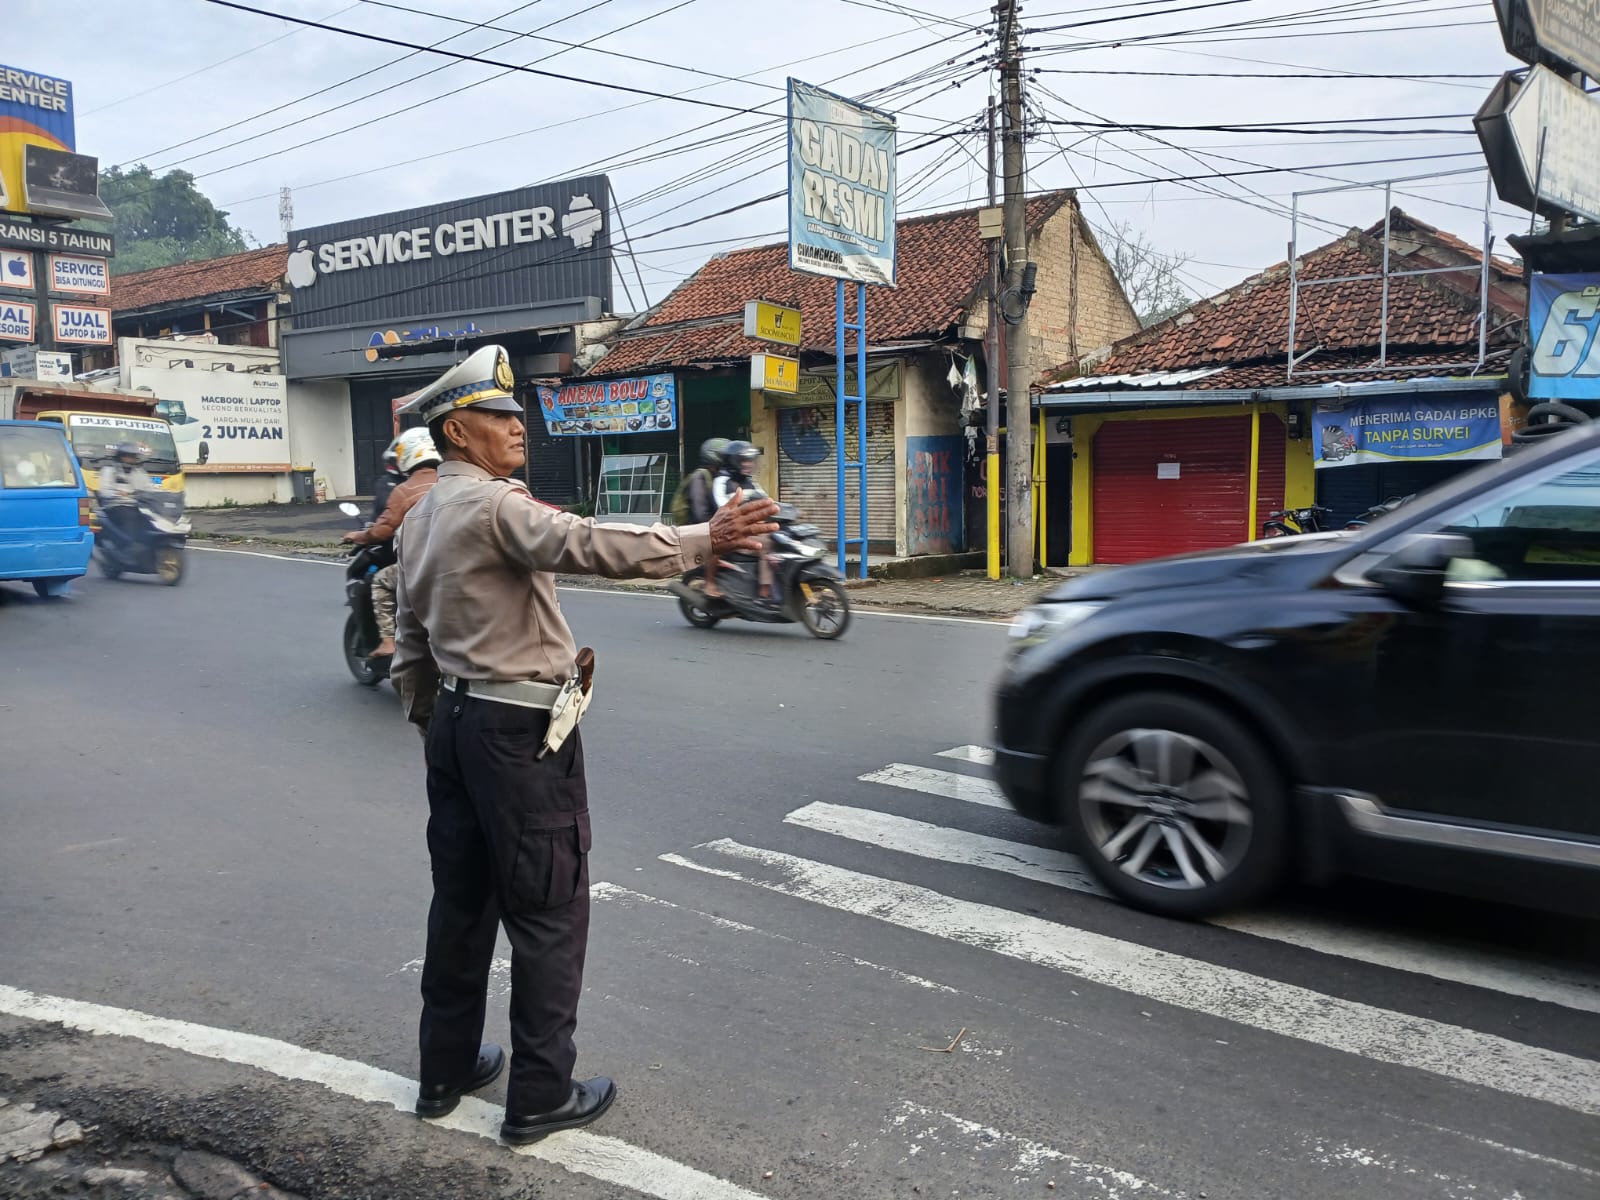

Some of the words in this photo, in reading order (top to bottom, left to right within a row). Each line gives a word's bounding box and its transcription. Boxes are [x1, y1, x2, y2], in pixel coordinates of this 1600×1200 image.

[799, 118, 889, 194] GADAI
[802, 168, 885, 242] RESMI
[49, 231, 58, 245] 5
[61, 233, 111, 252] TAHUN
[318, 227, 432, 273] SERVICE
[434, 206, 558, 256] CENTER
[55, 261, 104, 277] SERVICE
[55, 276, 71, 286] BISA
[72, 278, 106, 289] DITUNGGU
[0, 307, 29, 324] AL
[61, 310, 104, 329] JUAL
[59, 327, 89, 339] LAPTOP
[90, 330, 96, 339] &
[97, 331, 107, 340] HP
[201, 396, 245, 405] MACBOOK
[250, 398, 281, 406] LAPTOP
[558, 383, 605, 406] ANEKA
[609, 379, 649, 402] BOLU
[234, 406, 282, 414] BERKUALITAS
[1350, 412, 1411, 428] MENERIMA
[1414, 410, 1456, 421] GADAI
[1459, 407, 1497, 420] BPKB
[115, 419, 154, 430] PUTRI
[213, 416, 239, 424] HARGA
[202, 425, 213, 439] 2
[217, 425, 283, 440] JUTAAN
[1364, 428, 1410, 444] TANPA
[1412, 426, 1469, 441] SURVEI
